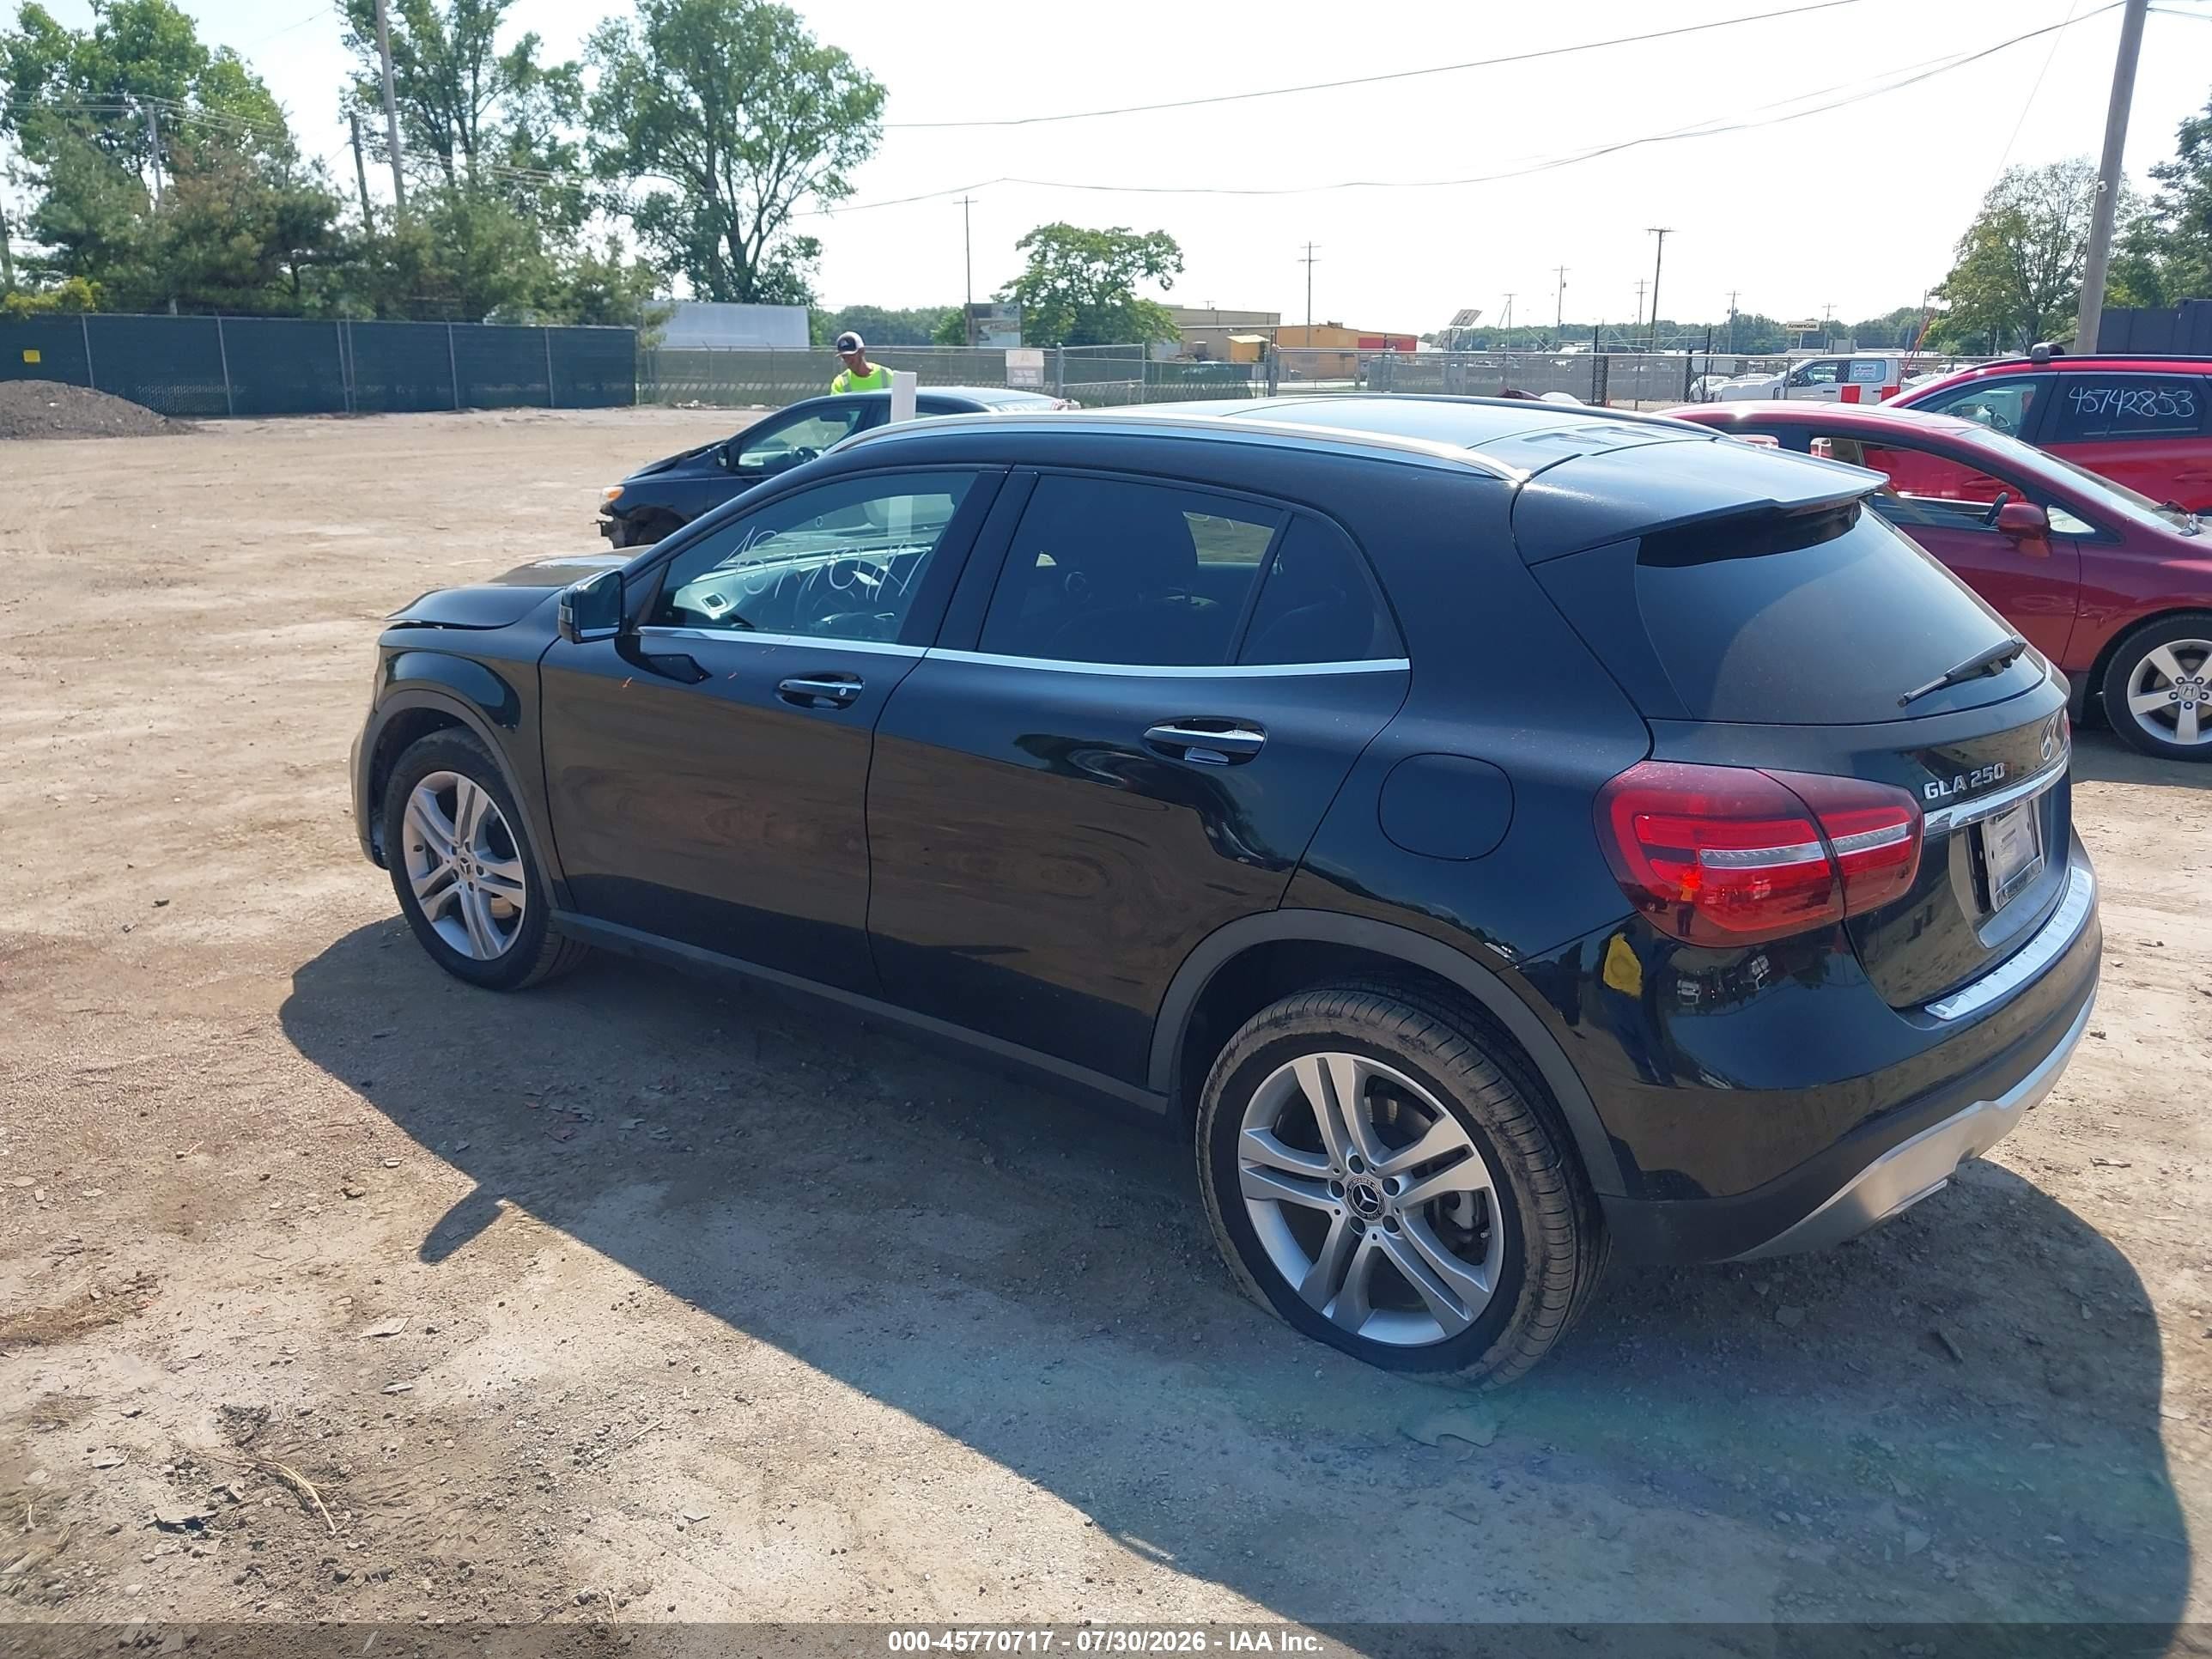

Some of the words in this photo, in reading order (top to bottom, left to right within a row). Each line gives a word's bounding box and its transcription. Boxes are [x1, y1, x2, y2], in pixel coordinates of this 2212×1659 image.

[2069, 386, 2195, 417] 45742853
[1923, 775, 1968, 799] GLA
[1970, 762, 2005, 788] 250
